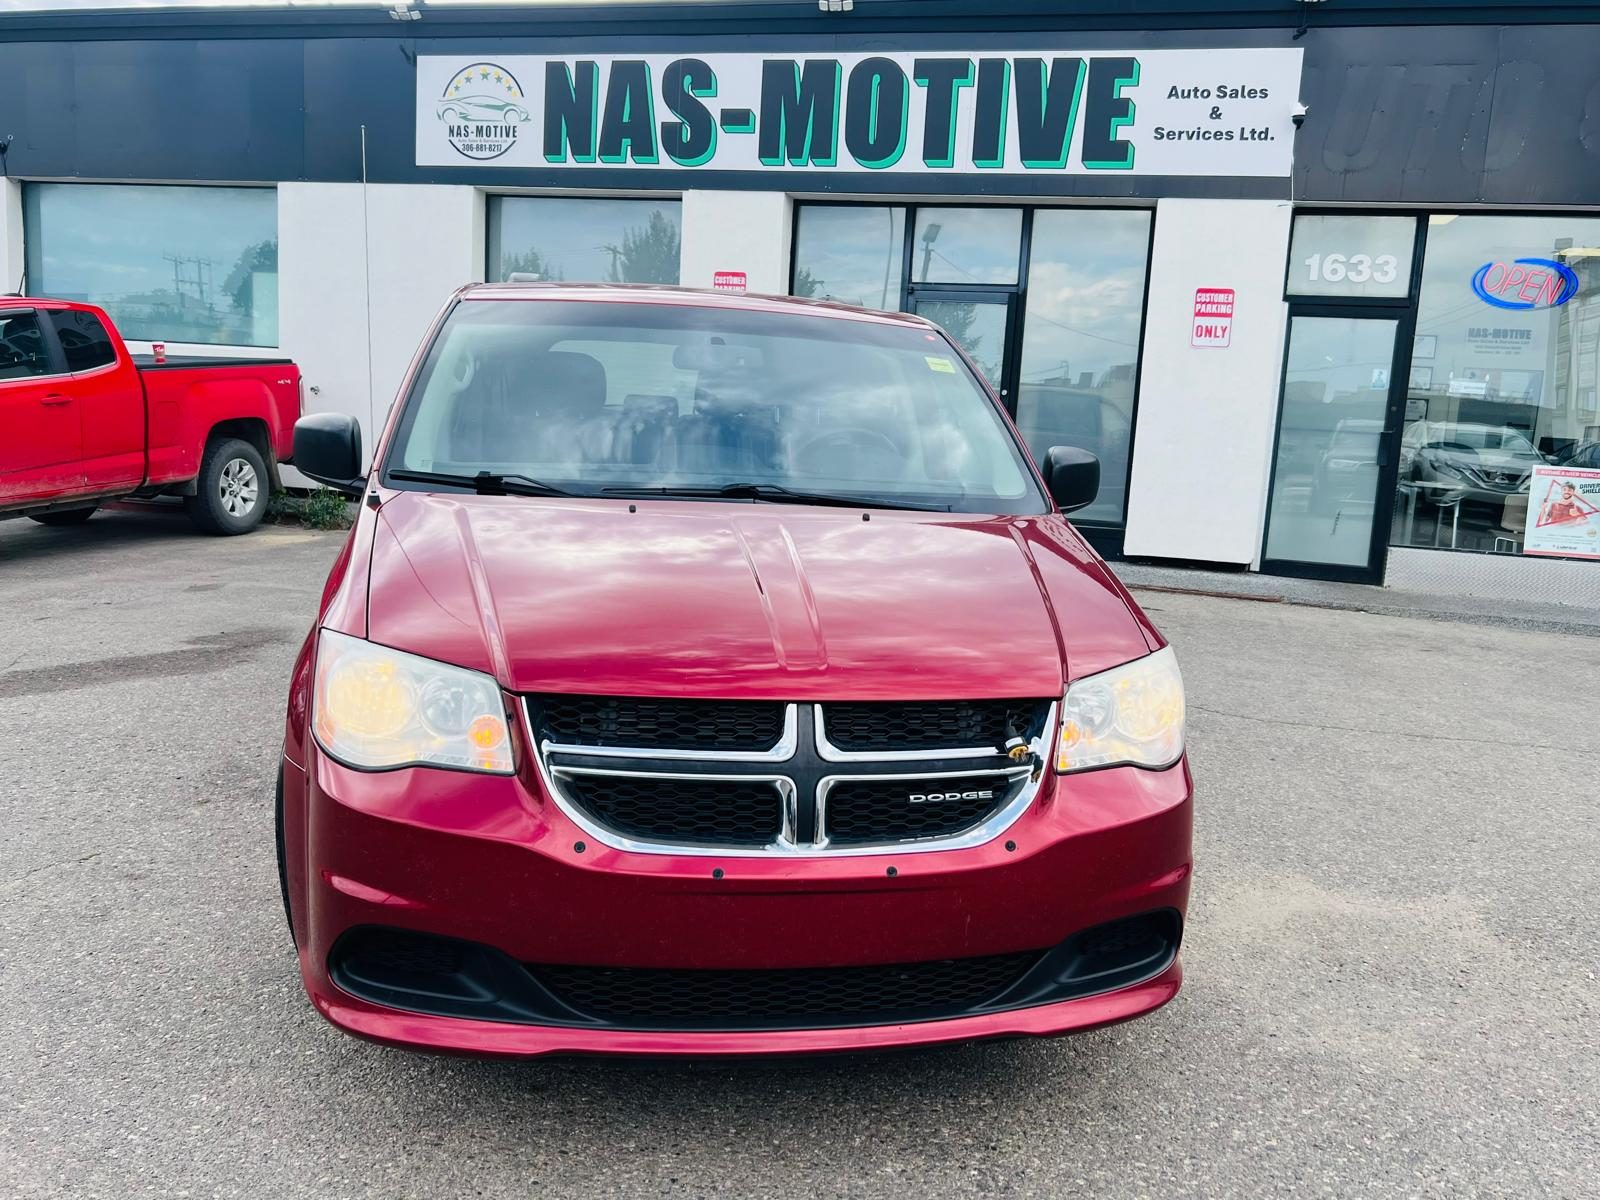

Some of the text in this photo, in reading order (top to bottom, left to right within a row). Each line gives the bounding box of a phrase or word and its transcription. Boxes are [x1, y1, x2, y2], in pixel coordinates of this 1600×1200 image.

[1167, 85, 1269, 99] Auto Sales
[543, 57, 1140, 170] NAS-MOTIVE
[1209, 105, 1222, 120] &
[448, 125, 518, 138] NAS-MOTIVE
[1153, 126, 1275, 141] Services Ltd.
[1304, 253, 1398, 284] 1633
[715, 276, 745, 285] CUSTOMER
[1482, 262, 1564, 304] OPEN
[1196, 293, 1233, 303] CUSTOMER
[1195, 303, 1232, 313] PARKING
[1195, 324, 1228, 338] ONLY
[909, 789, 993, 803] DODGE
